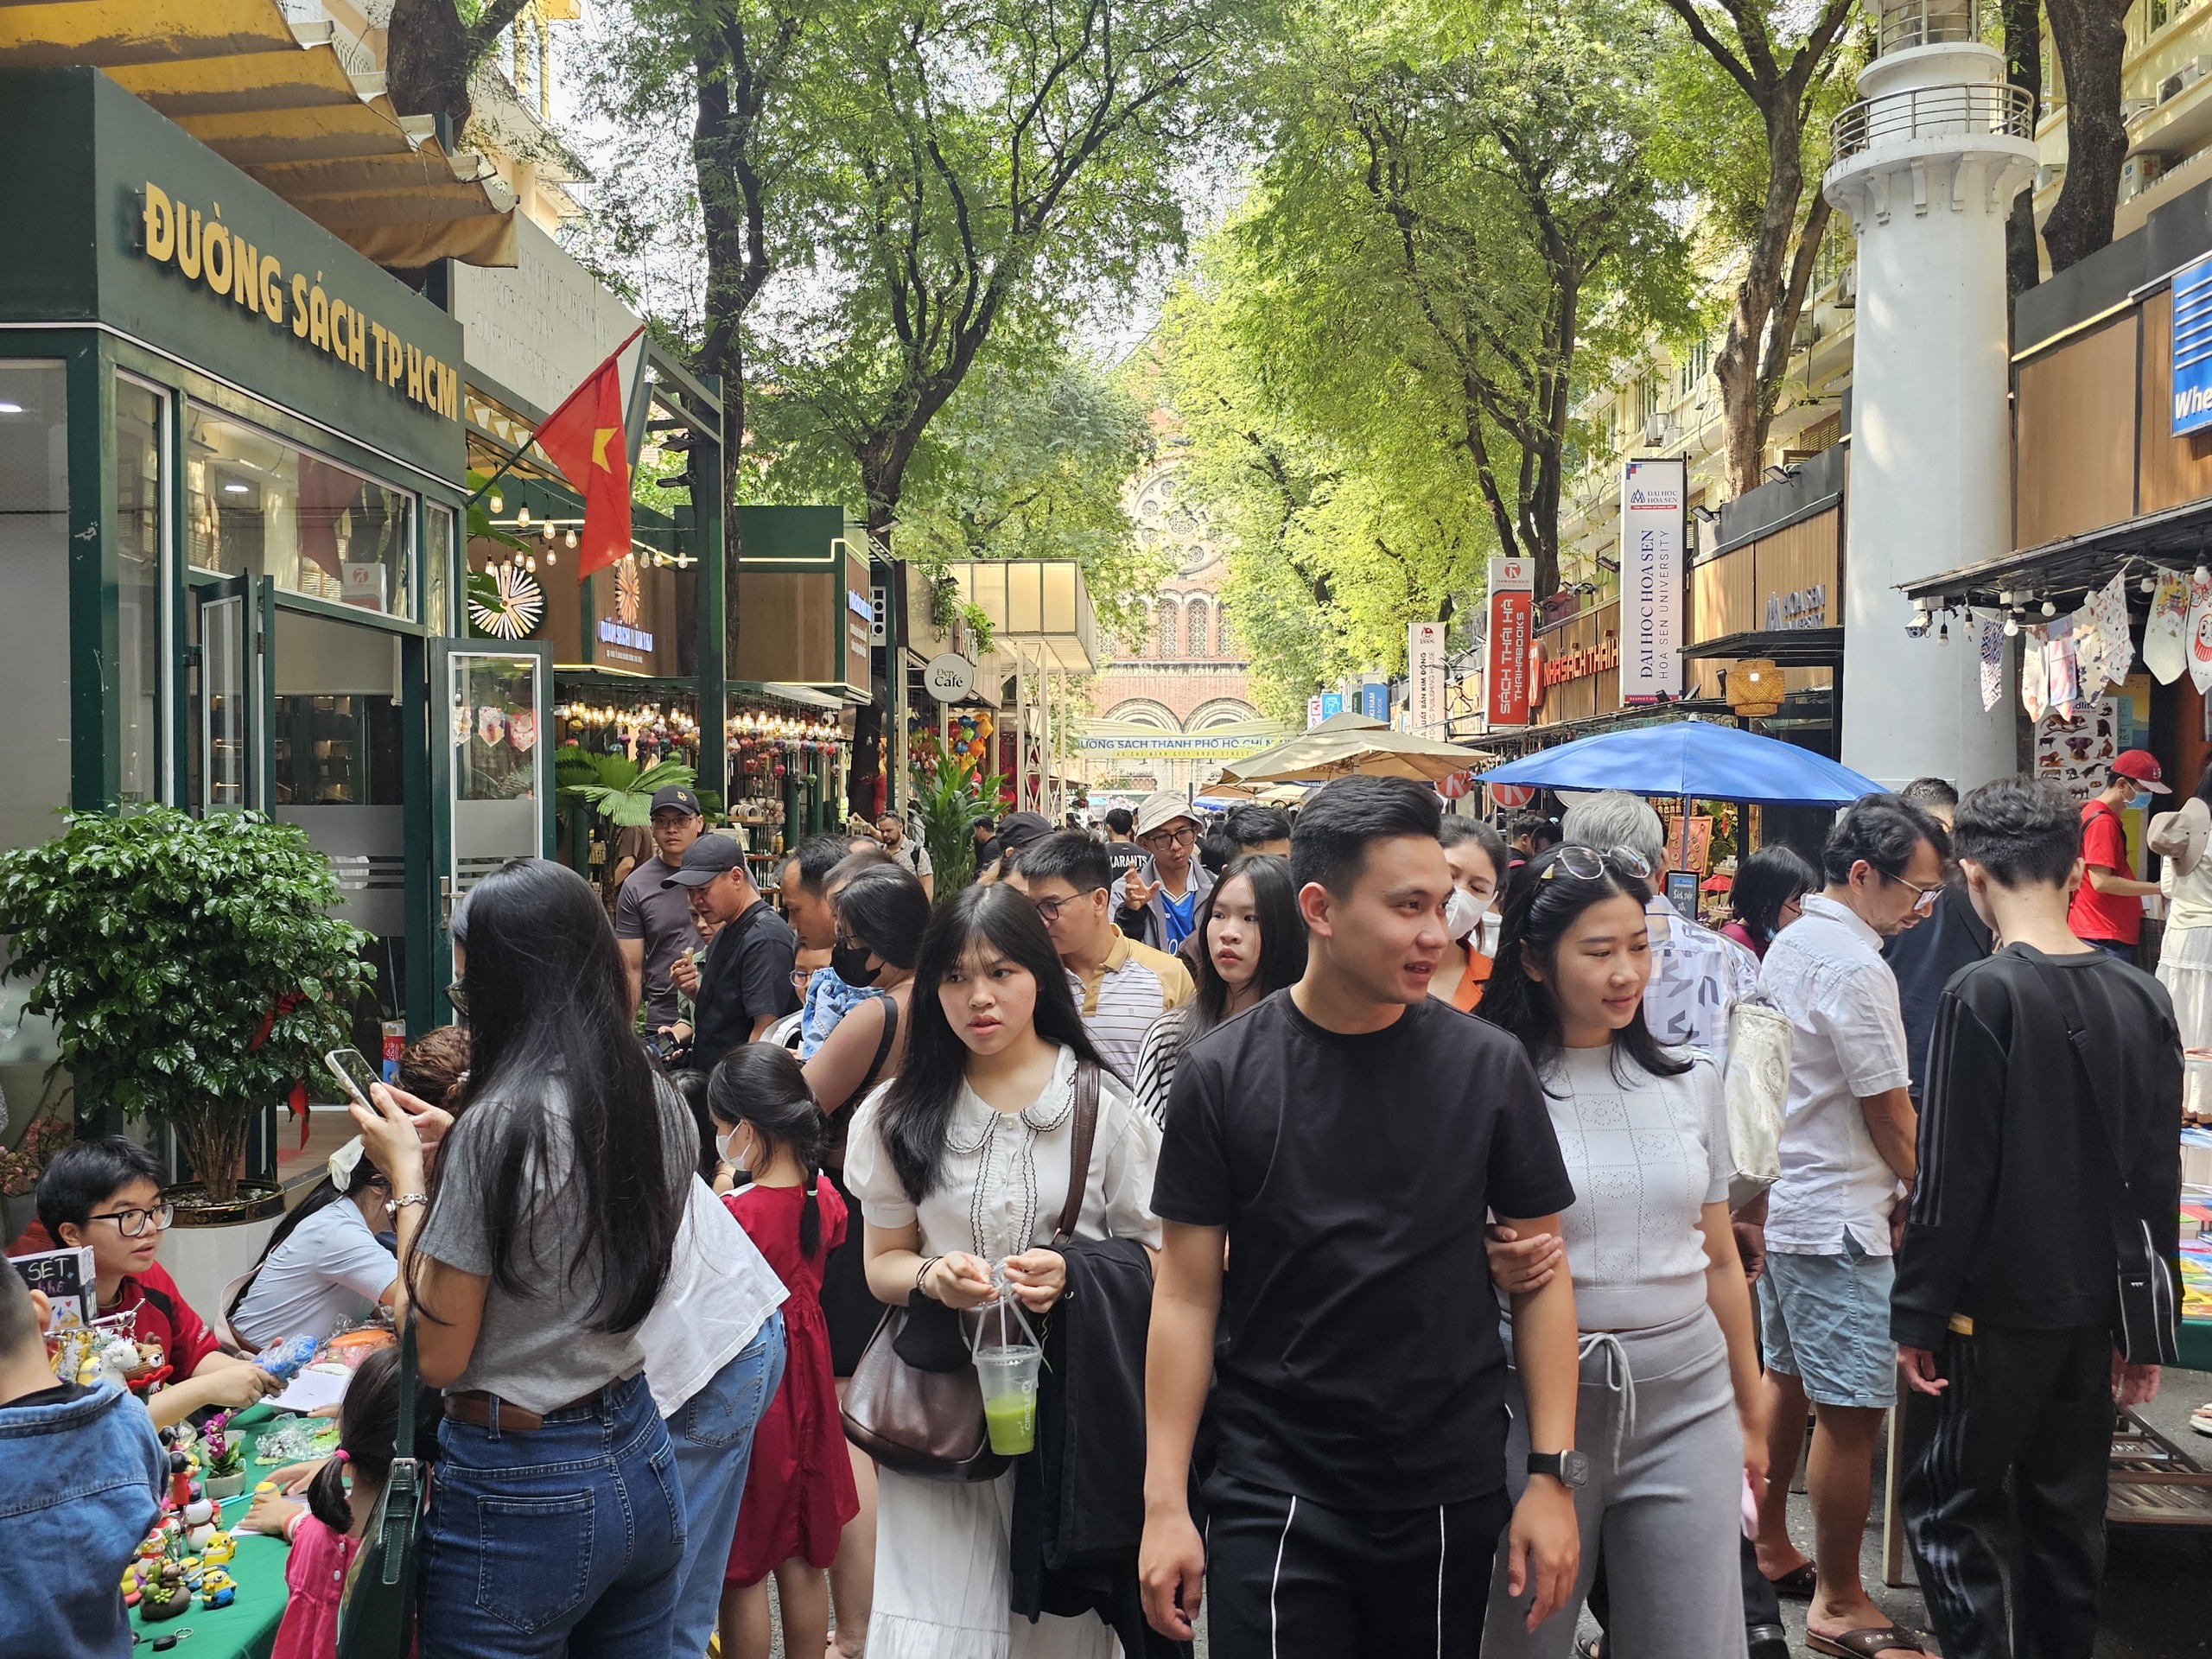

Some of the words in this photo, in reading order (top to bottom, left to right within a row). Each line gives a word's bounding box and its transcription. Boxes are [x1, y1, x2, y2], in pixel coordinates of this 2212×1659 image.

[143, 181, 283, 324] ĐƯỜNG
[291, 270, 365, 372] SÁCH
[1640, 530, 1654, 562] SEN
[1640, 565, 1654, 602] HOA
[1659, 530, 1669, 613] UNIVERSITY
[1500, 599, 1514, 623] HÀ
[1640, 607, 1655, 645] HỌC
[1499, 627, 1513, 665] THÁI
[1659, 620, 1669, 645] SEN
[1514, 612, 1524, 702] THAIHABOOKS
[1640, 649, 1655, 679] ĐẠI
[1659, 652, 1669, 679] HOA
[934, 674, 963, 688] Café
[1497, 669, 1512, 715] SÁCH
[1117, 737, 1148, 749] SÁCH
[1151, 737, 1192, 749] THÀNH
